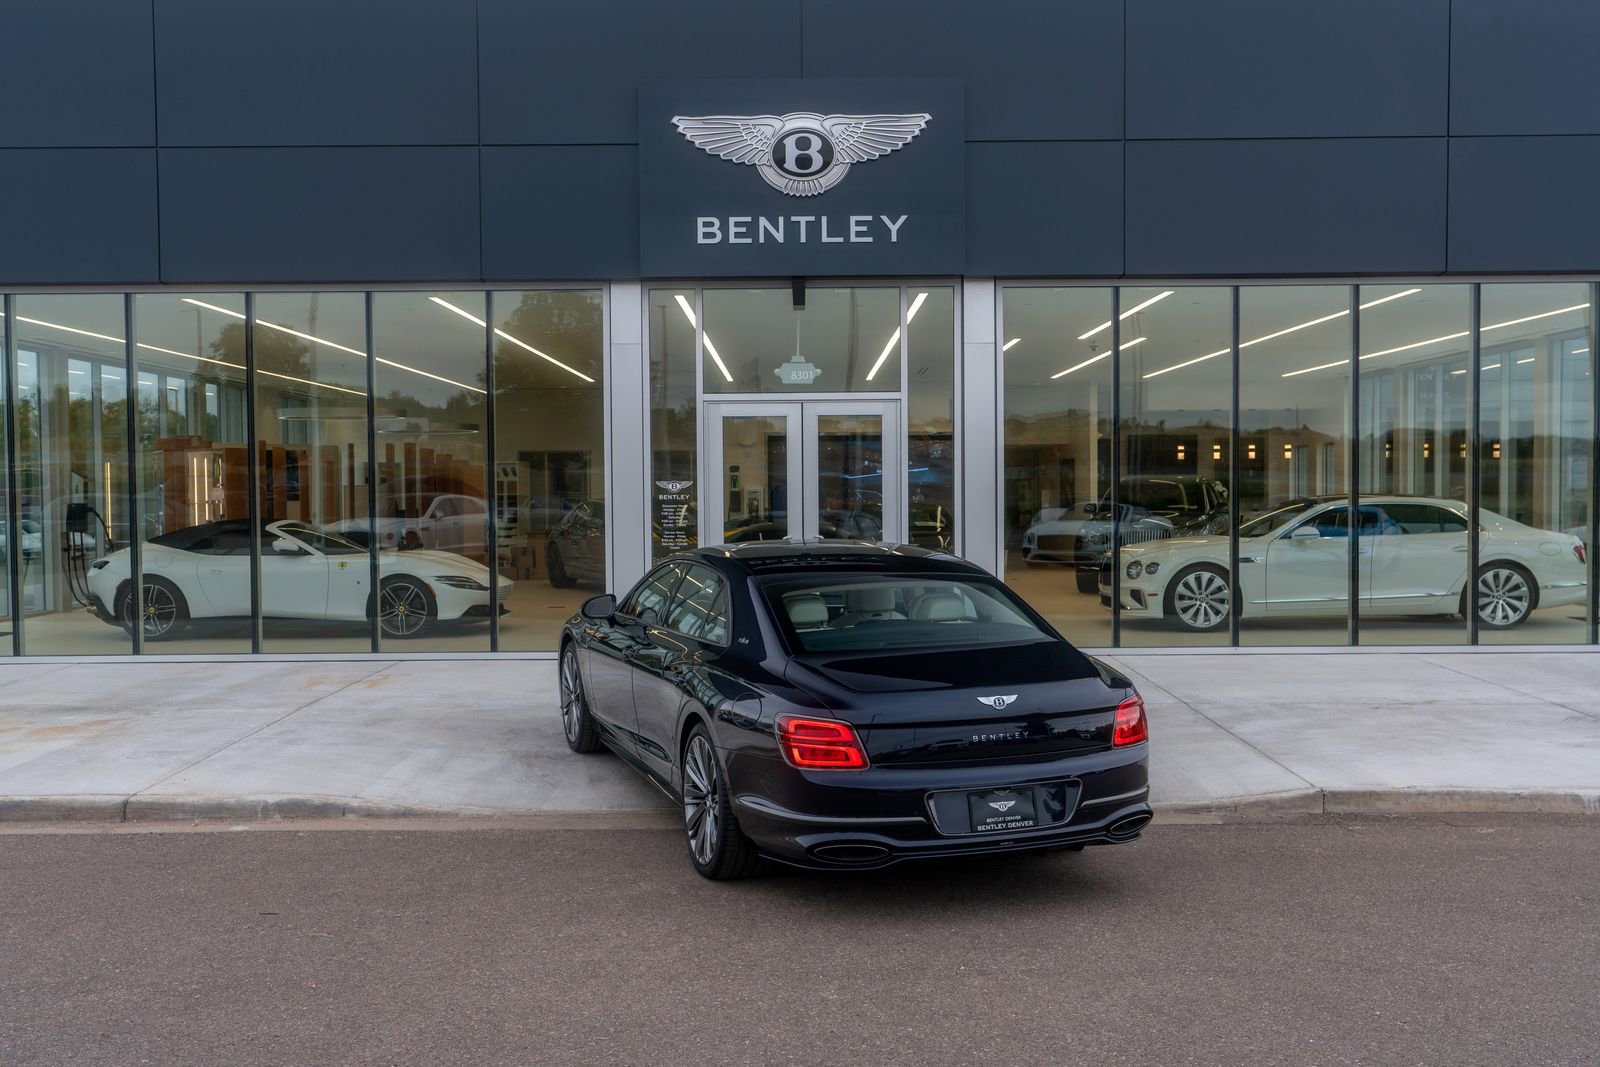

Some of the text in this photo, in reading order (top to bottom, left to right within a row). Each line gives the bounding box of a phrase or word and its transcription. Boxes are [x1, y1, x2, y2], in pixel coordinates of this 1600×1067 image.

[782, 132, 824, 174] B
[696, 214, 909, 244] BENTLEY
[791, 370, 813, 380] 8301
[972, 731, 1029, 742] BENTLEY
[977, 820, 1034, 831] BENTLEY DENVER
